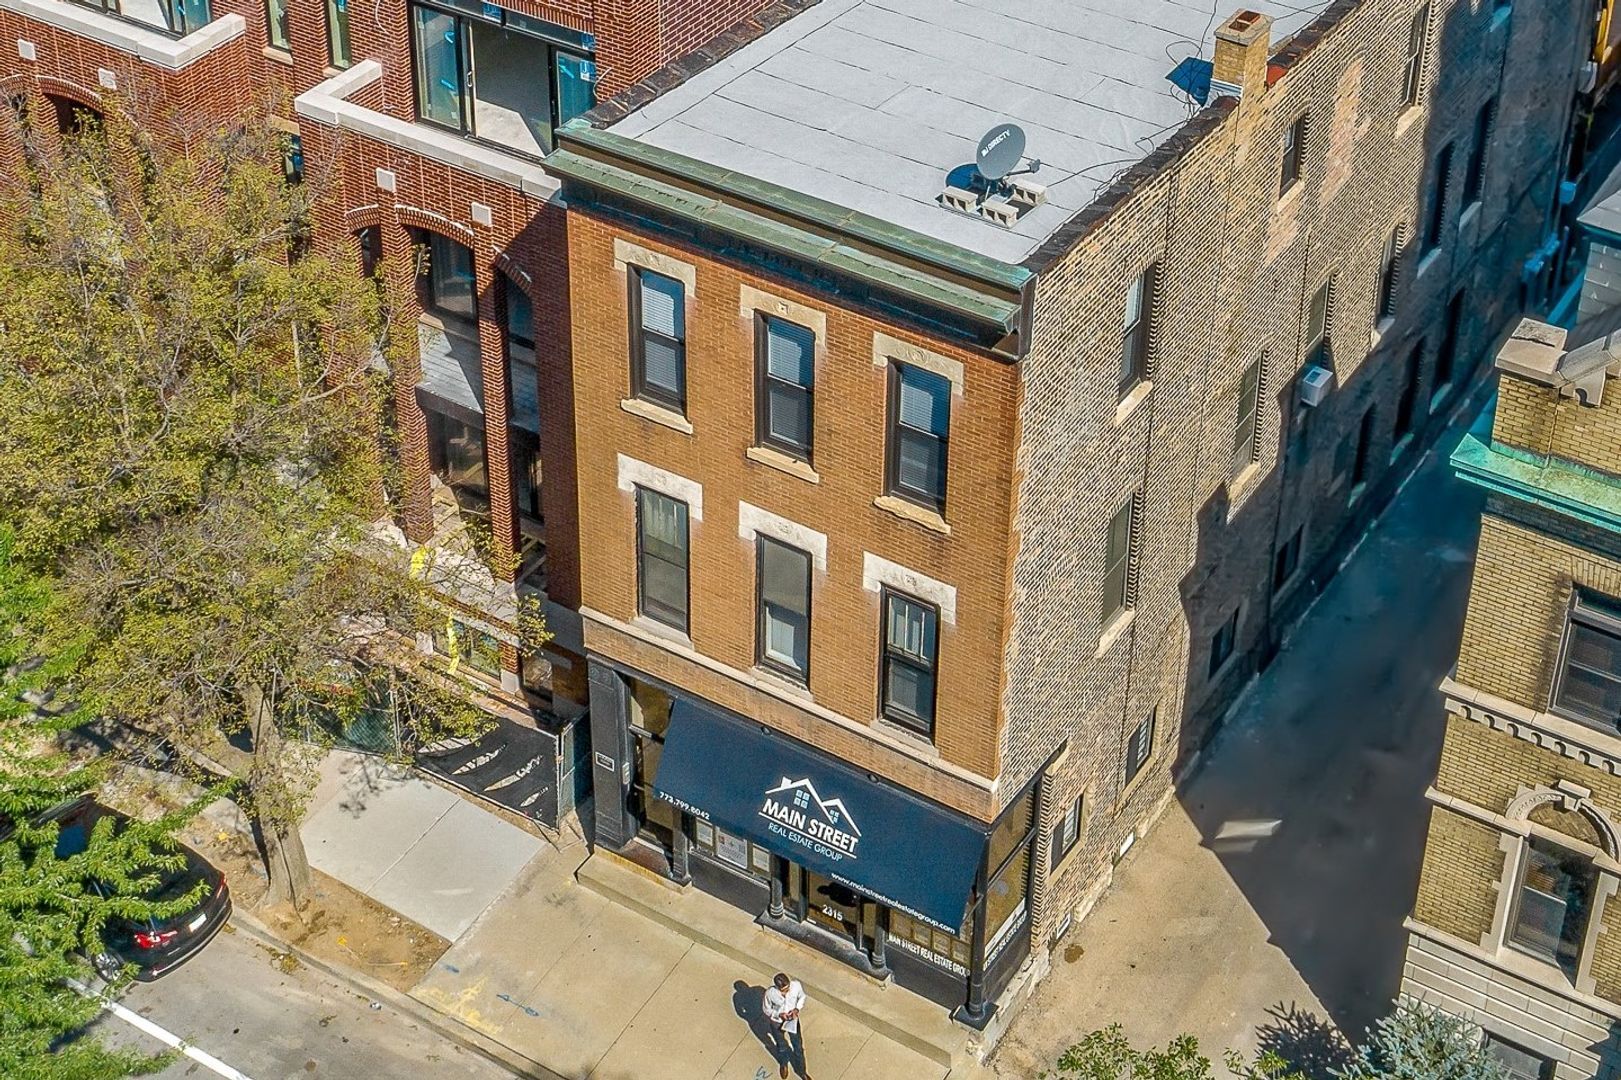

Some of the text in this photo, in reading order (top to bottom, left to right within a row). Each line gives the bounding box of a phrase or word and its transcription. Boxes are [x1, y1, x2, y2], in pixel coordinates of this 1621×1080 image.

[762, 798, 859, 853] MAIN STREET
[768, 822, 843, 861] REAL ESTATE GROUP
[822, 904, 843, 921] 2315
[902, 939, 921, 955] STREET
[920, 947, 934, 962] REAL
[934, 953, 953, 970] ESTATE
